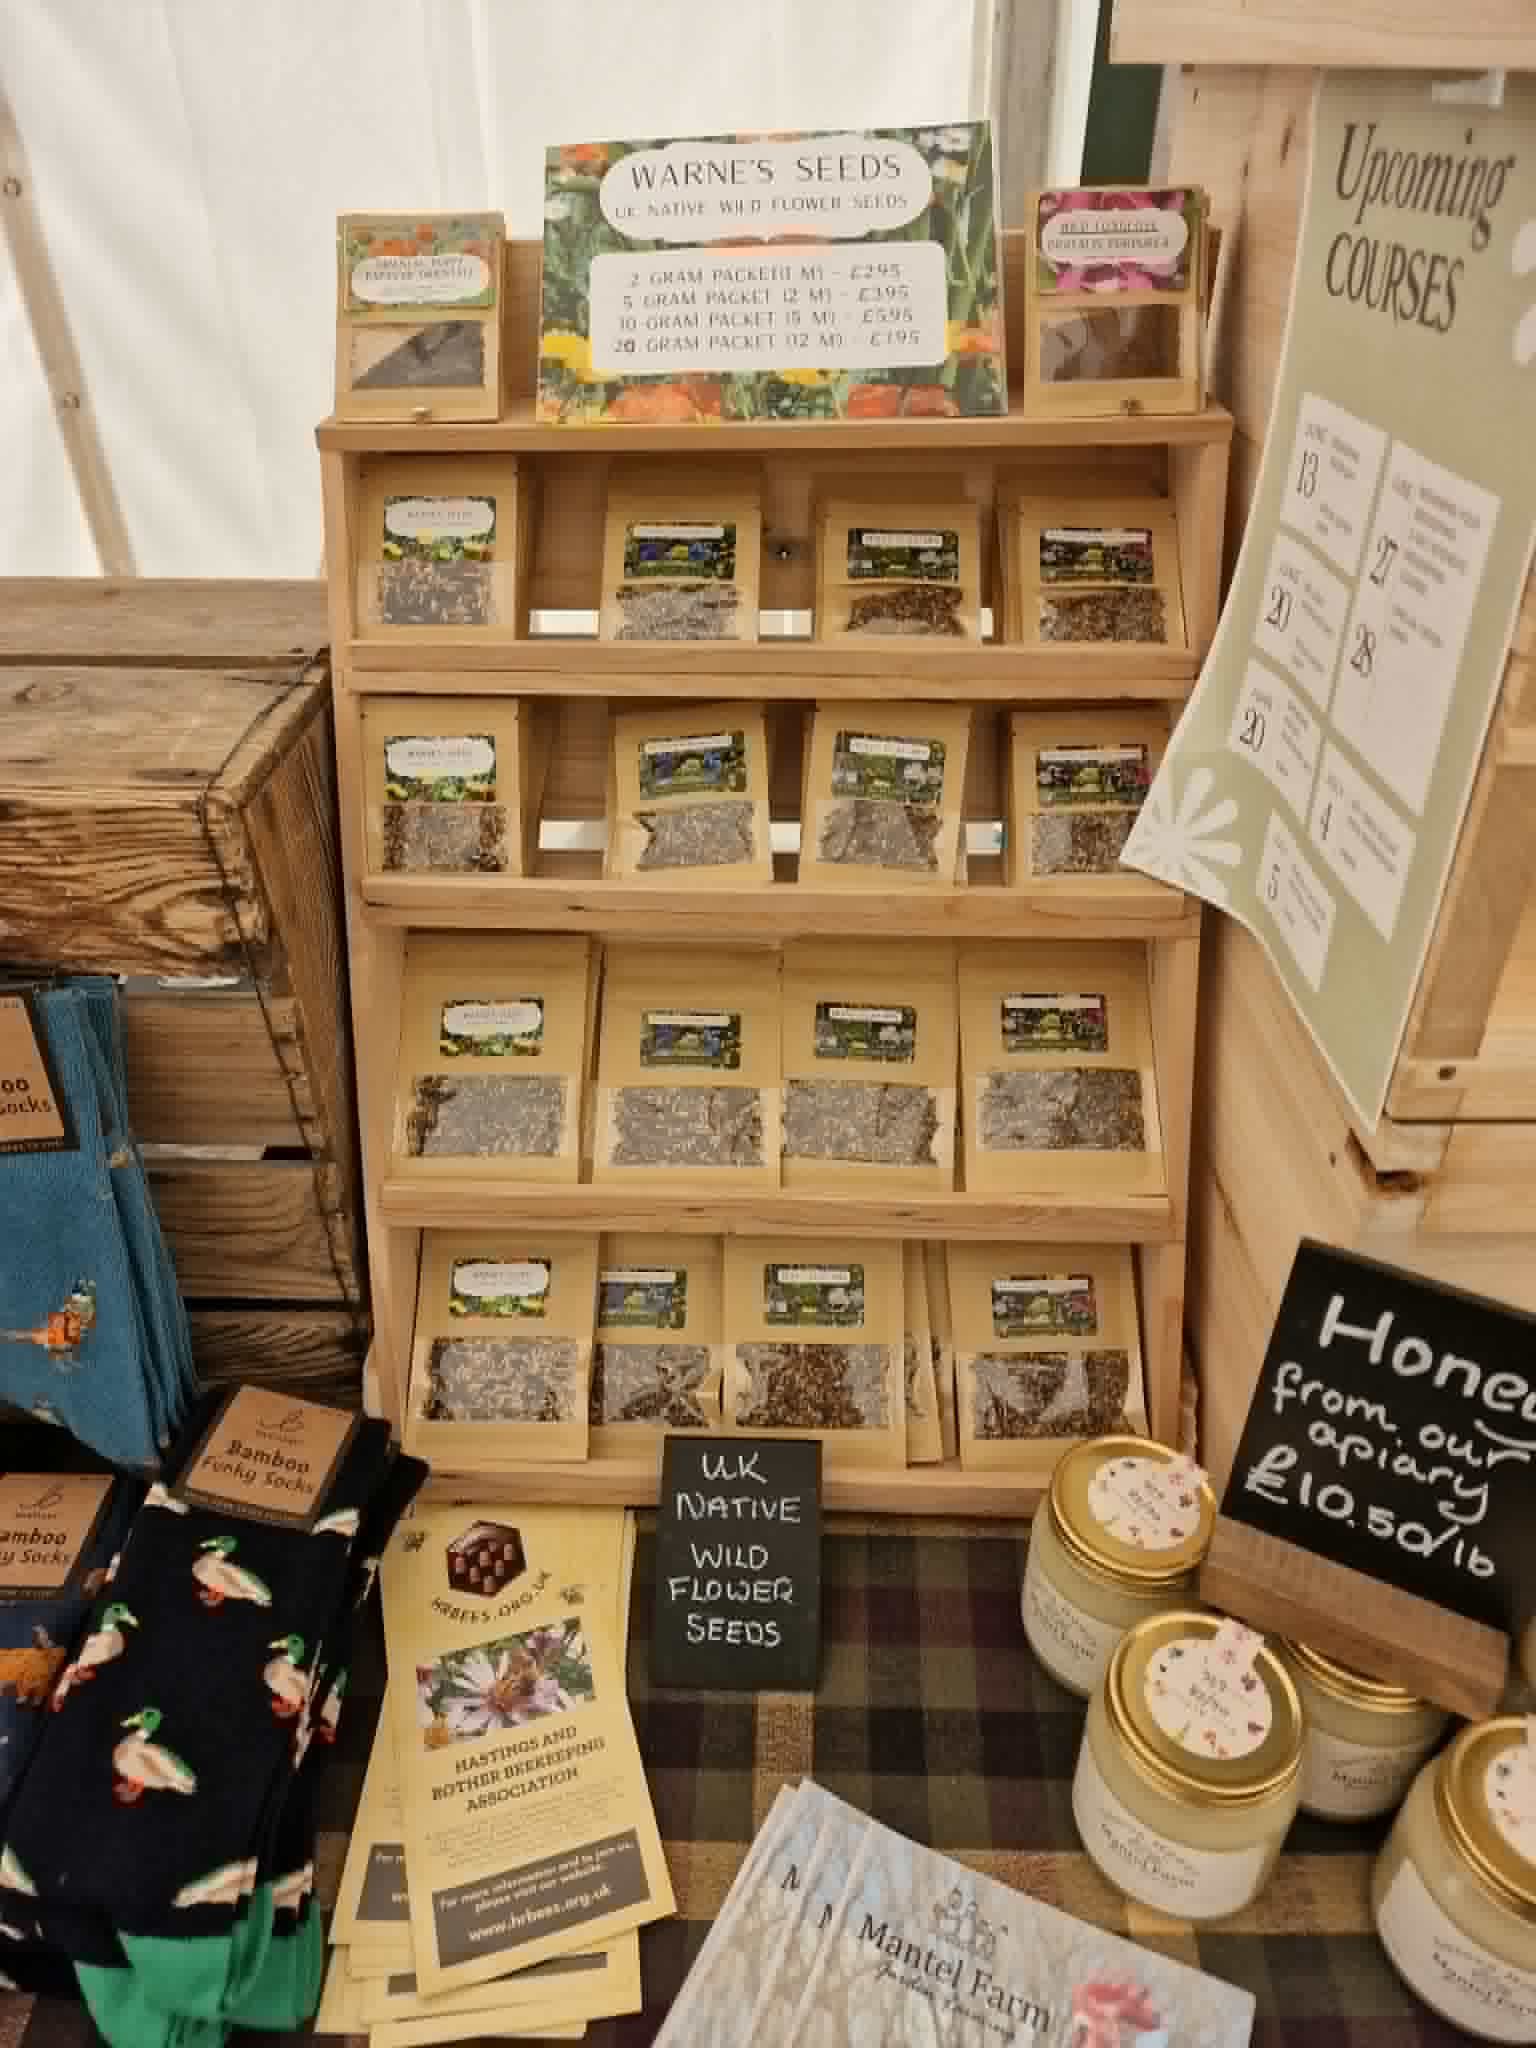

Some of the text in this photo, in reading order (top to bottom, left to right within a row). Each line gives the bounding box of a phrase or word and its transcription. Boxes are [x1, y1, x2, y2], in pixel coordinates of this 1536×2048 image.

[631, 151, 902, 190] WARNE'S SEEDS
[1335, 122, 1516, 253] Upcoming
[647, 199, 704, 217] NATIVE
[719, 197, 761, 216] WILD
[771, 194, 841, 213] FLOWER
[849, 192, 907, 210] SEEDS
[641, 288, 697, 307] GRAM
[706, 286, 769, 305] PACKET
[649, 268, 704, 286] GRAM
[1327, 231, 1465, 334] COURSES
[646, 312, 699, 329] GRAM
[709, 311, 777, 329] PACKET
[646, 335, 699, 352] GRAM
[709, 333, 777, 352] PACKET
[1296, 449, 1319, 499] 13
[1369, 535, 1399, 588] 27
[1264, 584, 1294, 633] 20
[1350, 623, 1377, 678] 28
[1239, 707, 1266, 752] 20
[1272, 1362, 1532, 1468] from our
[224, 1440, 310, 1473] Bamboo
[702, 1451, 768, 1485] UK
[1307, 1420, 1490, 1525] apiary
[264, 1471, 315, 1495] Socks
[676, 1491, 802, 1524] NATIVE
[690, 1543, 769, 1571] WILD
[667, 1576, 794, 1605] FLOWER
[687, 1612, 782, 1649] SEEDS
[431, 1736, 606, 1801] ROTHER BEEKEEPING
[455, 1725, 577, 1775] HASTINGS AND
[466, 1767, 578, 1814] ASSOCIATION
[859, 1912, 963, 1988] Mantel
[970, 1967, 1050, 2033] Farm
